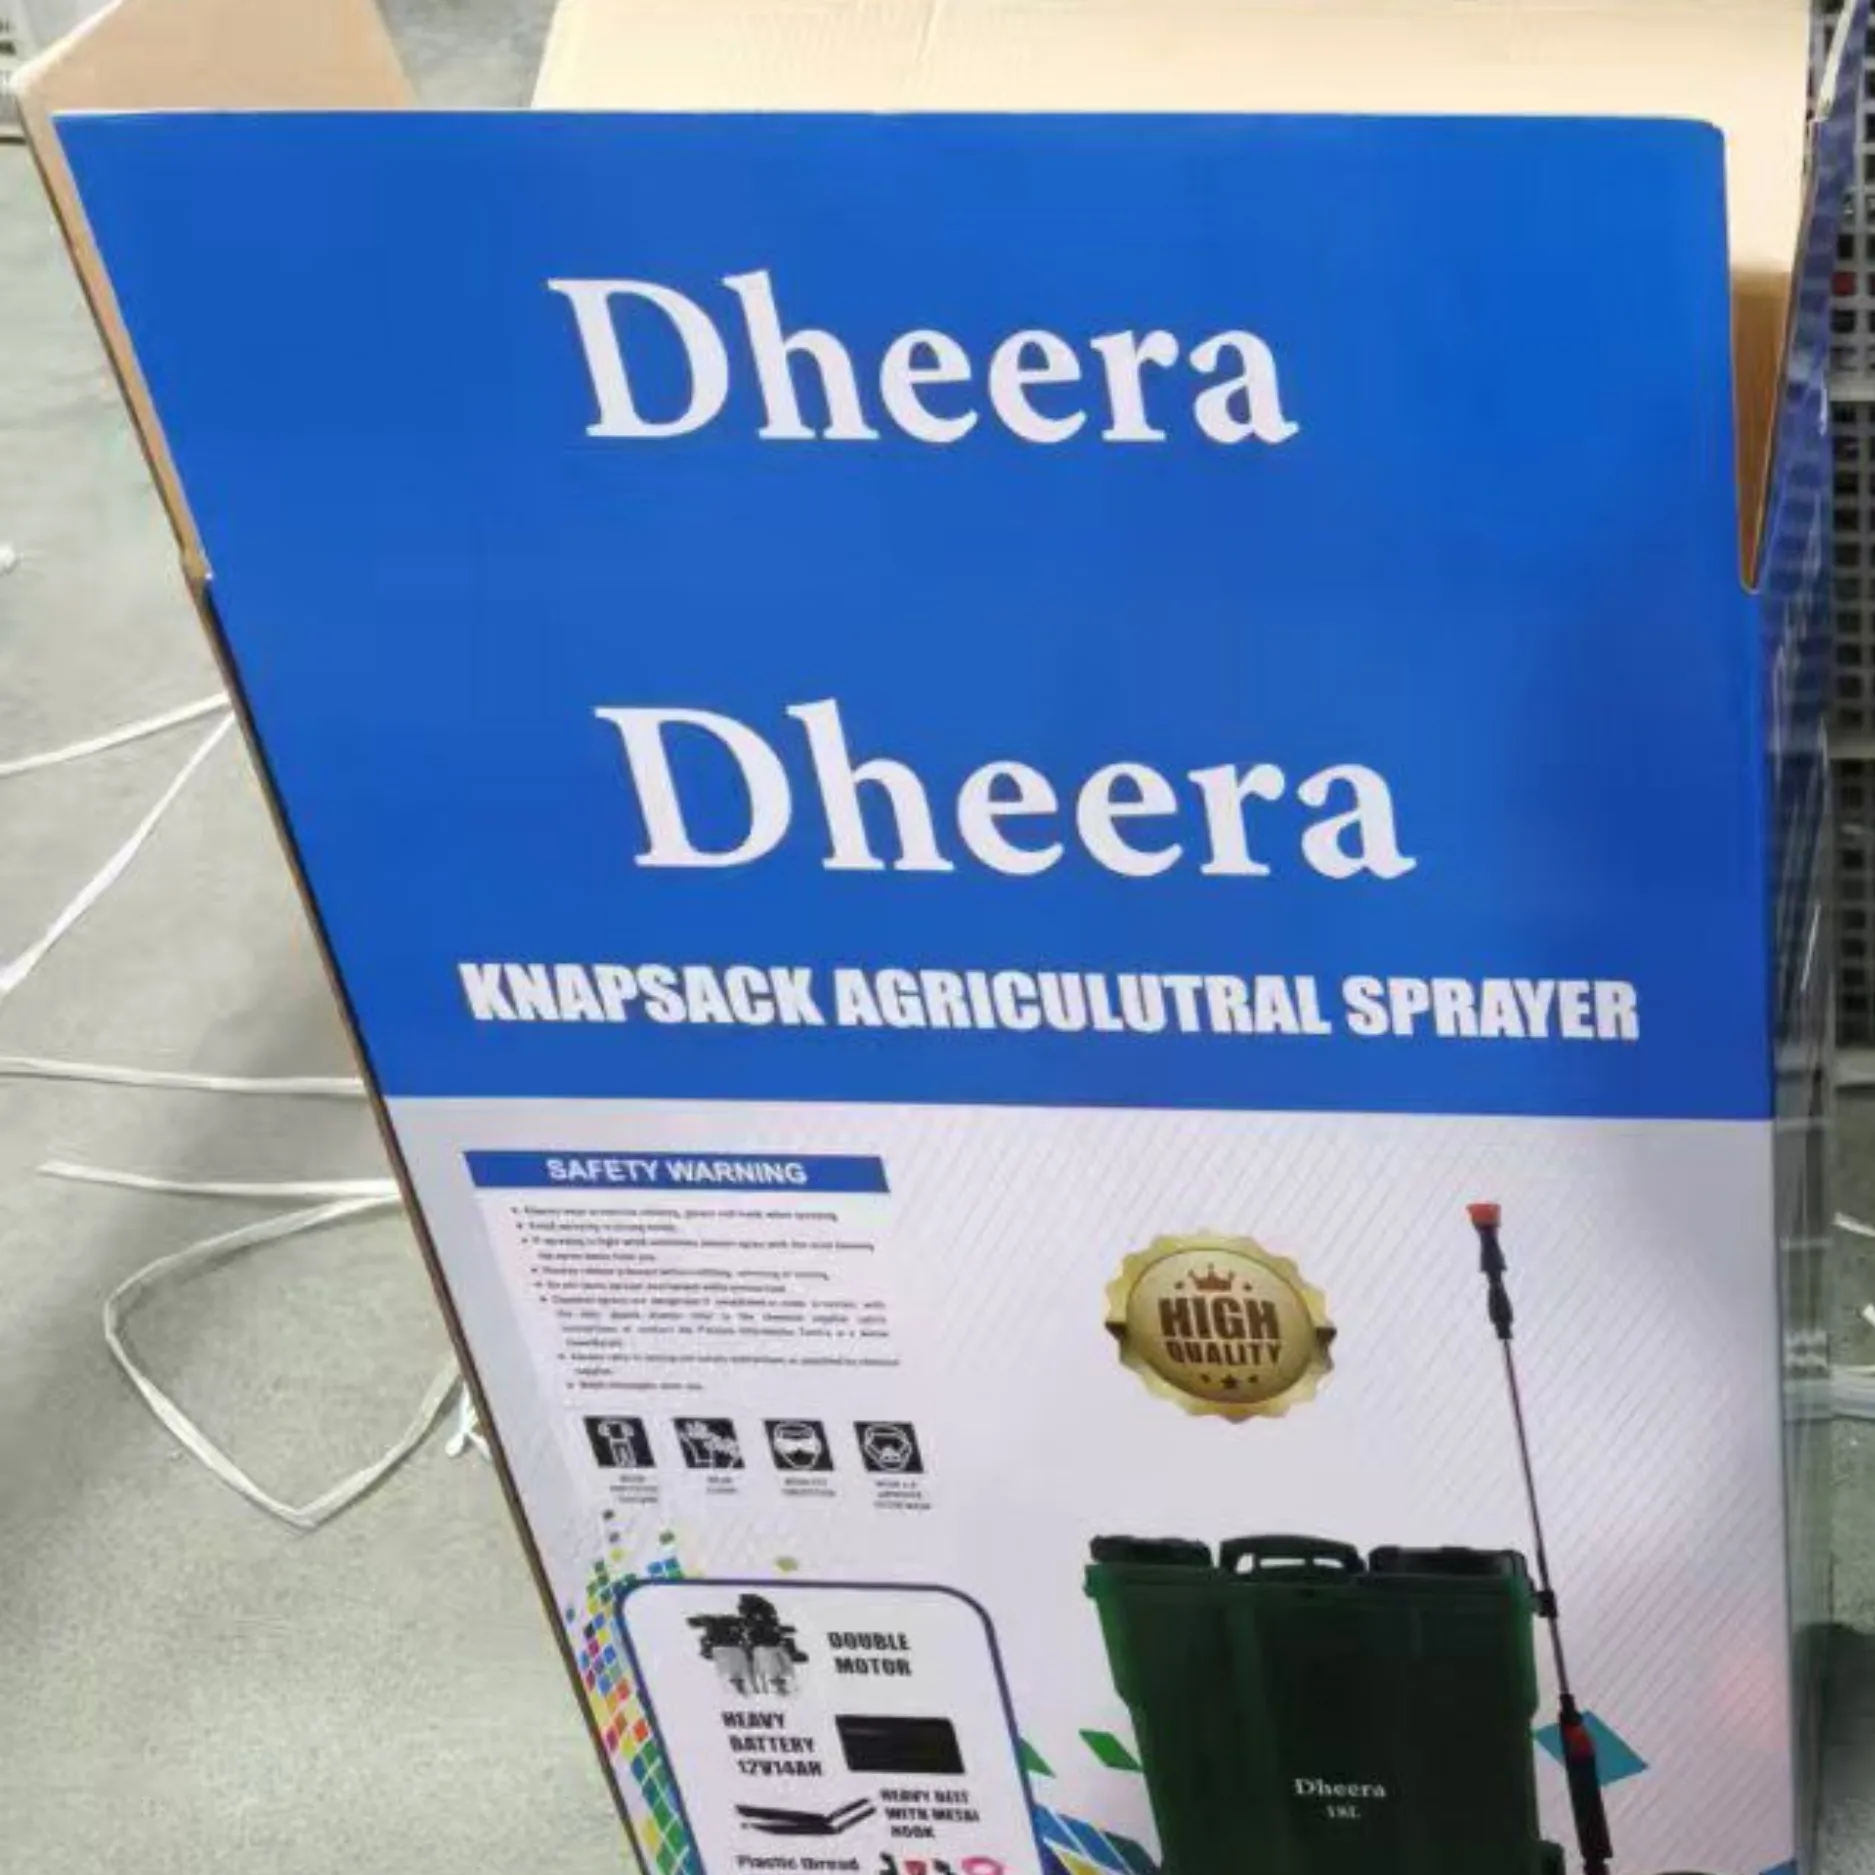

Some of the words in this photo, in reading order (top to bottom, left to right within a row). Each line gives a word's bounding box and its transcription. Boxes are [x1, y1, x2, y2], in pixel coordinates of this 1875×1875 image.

[548, 270, 1299, 445] Dheera
[594, 698, 1417, 878] Dheera
[458, 963, 825, 1026] KNAPSACK
[833, 969, 1332, 1035] AGRICULUTRAL
[1342, 975, 1640, 1041] SPRAYER
[545, 1159, 661, 1181] SAFETY
[667, 1161, 808, 1185] WARNING
[1157, 1296, 1281, 1341] HIGH
[1163, 1340, 1283, 1366] QUALITY
[827, 1631, 911, 1651] DOUBLE
[834, 1656, 913, 1676] MOTOR
[722, 1711, 786, 1729] HEAVY
[729, 1736, 815, 1754] BATTERY
[1294, 1777, 1387, 1798] Dheera
